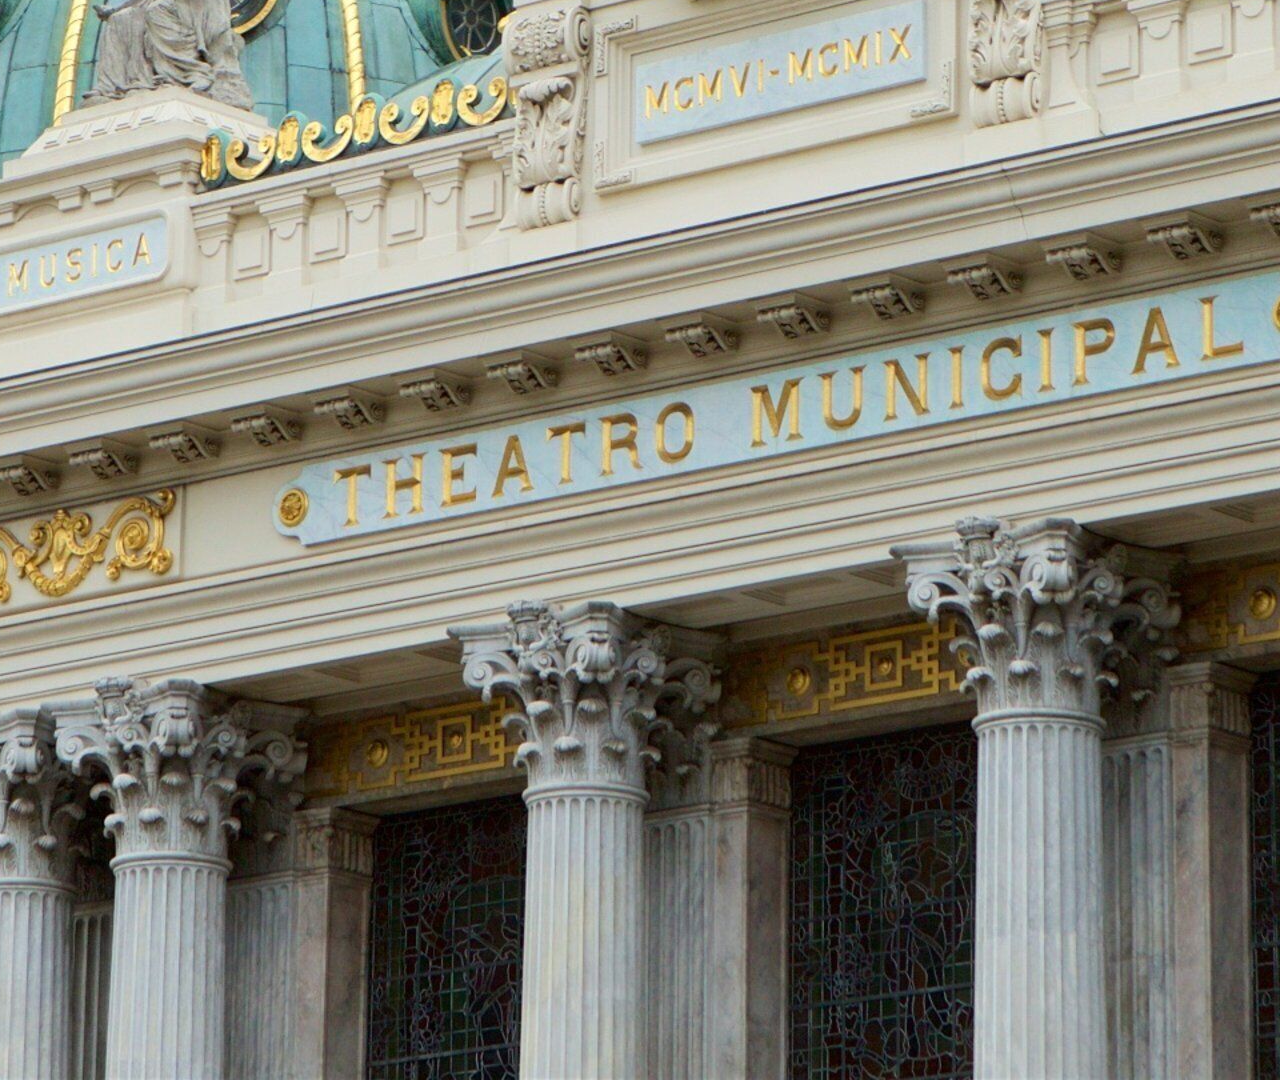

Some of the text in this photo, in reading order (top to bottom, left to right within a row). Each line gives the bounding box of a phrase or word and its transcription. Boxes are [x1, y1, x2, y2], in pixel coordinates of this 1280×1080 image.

[7, 231, 153, 297] MUSICA
[331, 296, 1246, 528] THEATRO MUNICIPAL
